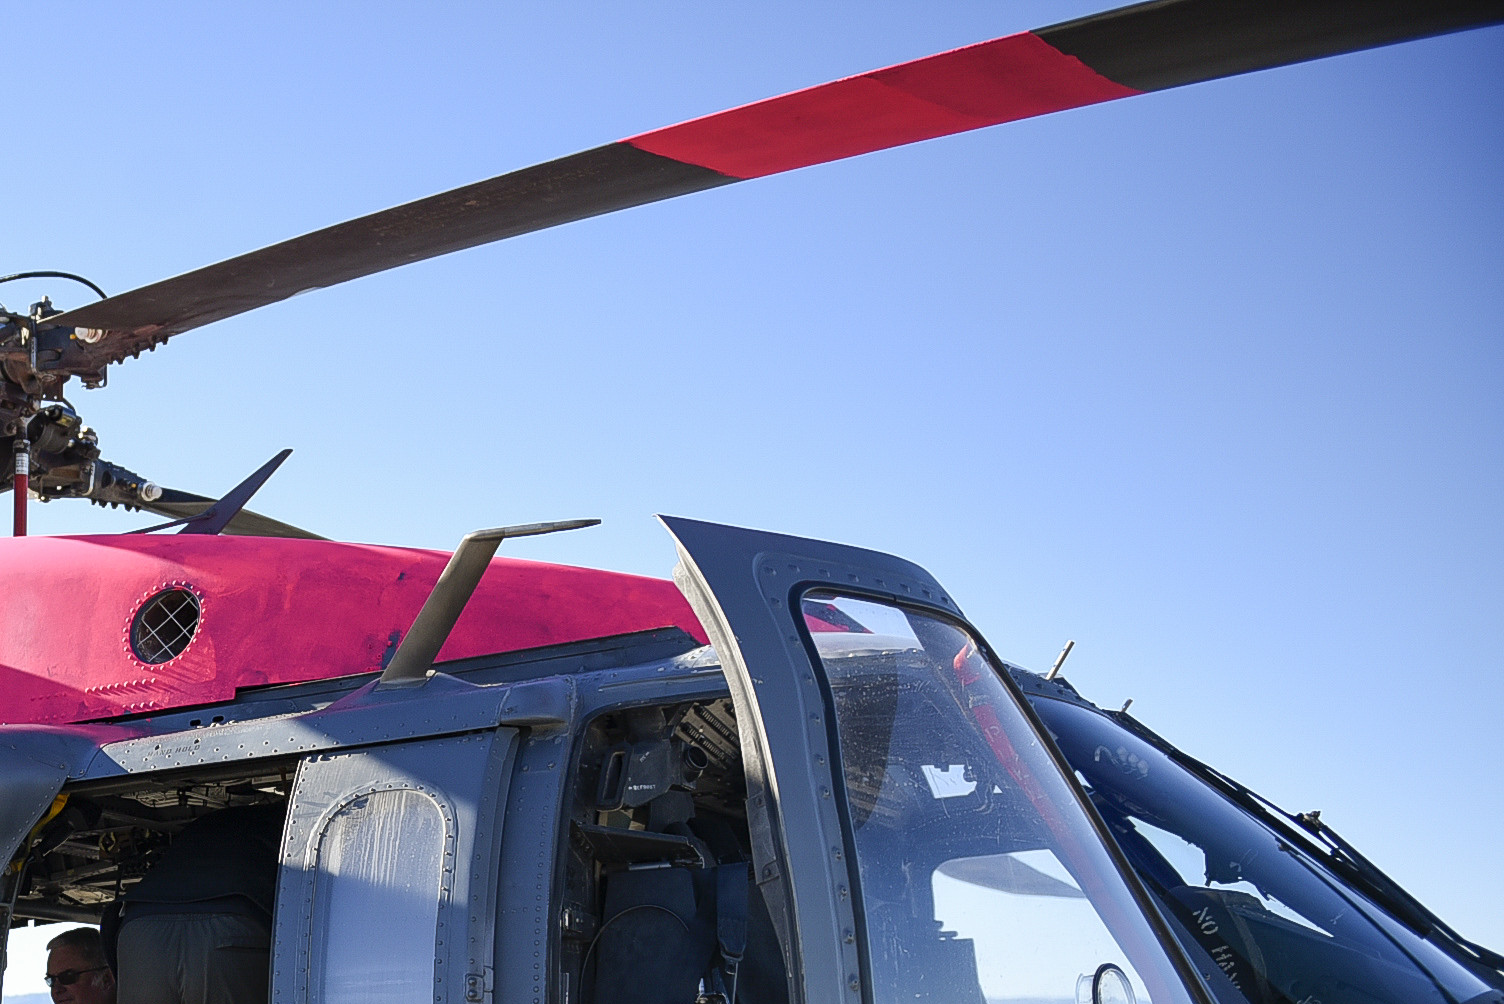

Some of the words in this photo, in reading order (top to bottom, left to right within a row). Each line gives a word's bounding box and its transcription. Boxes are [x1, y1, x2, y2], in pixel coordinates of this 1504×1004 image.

[147, 749, 172, 757] HAND
[175, 745, 200, 753] HOLD
[1193, 906, 1219, 936] NO
